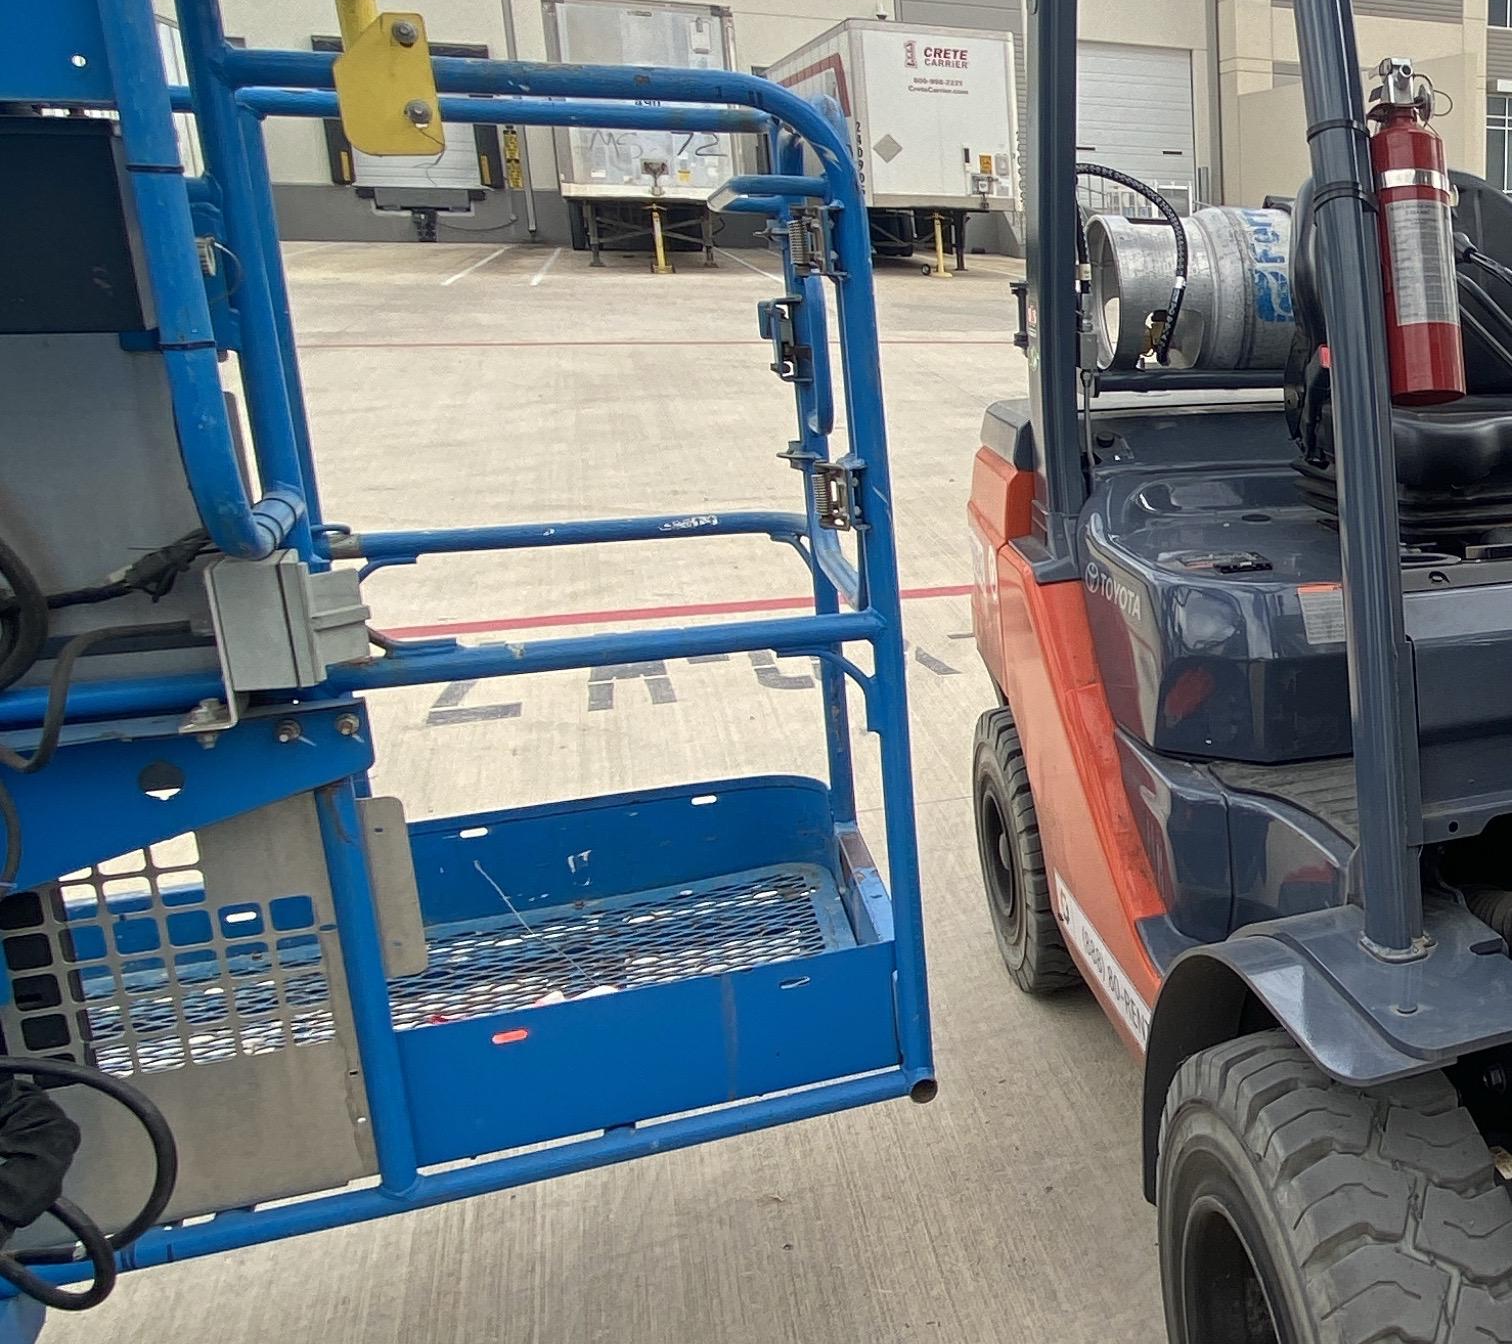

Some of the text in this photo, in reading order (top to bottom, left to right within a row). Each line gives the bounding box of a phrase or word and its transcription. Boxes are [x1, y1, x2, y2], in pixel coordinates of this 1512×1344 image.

[923, 47, 969, 61] CRETE
[924, 58, 969, 69] CARRIER
[1100, 572, 1141, 621] TOYOTA
